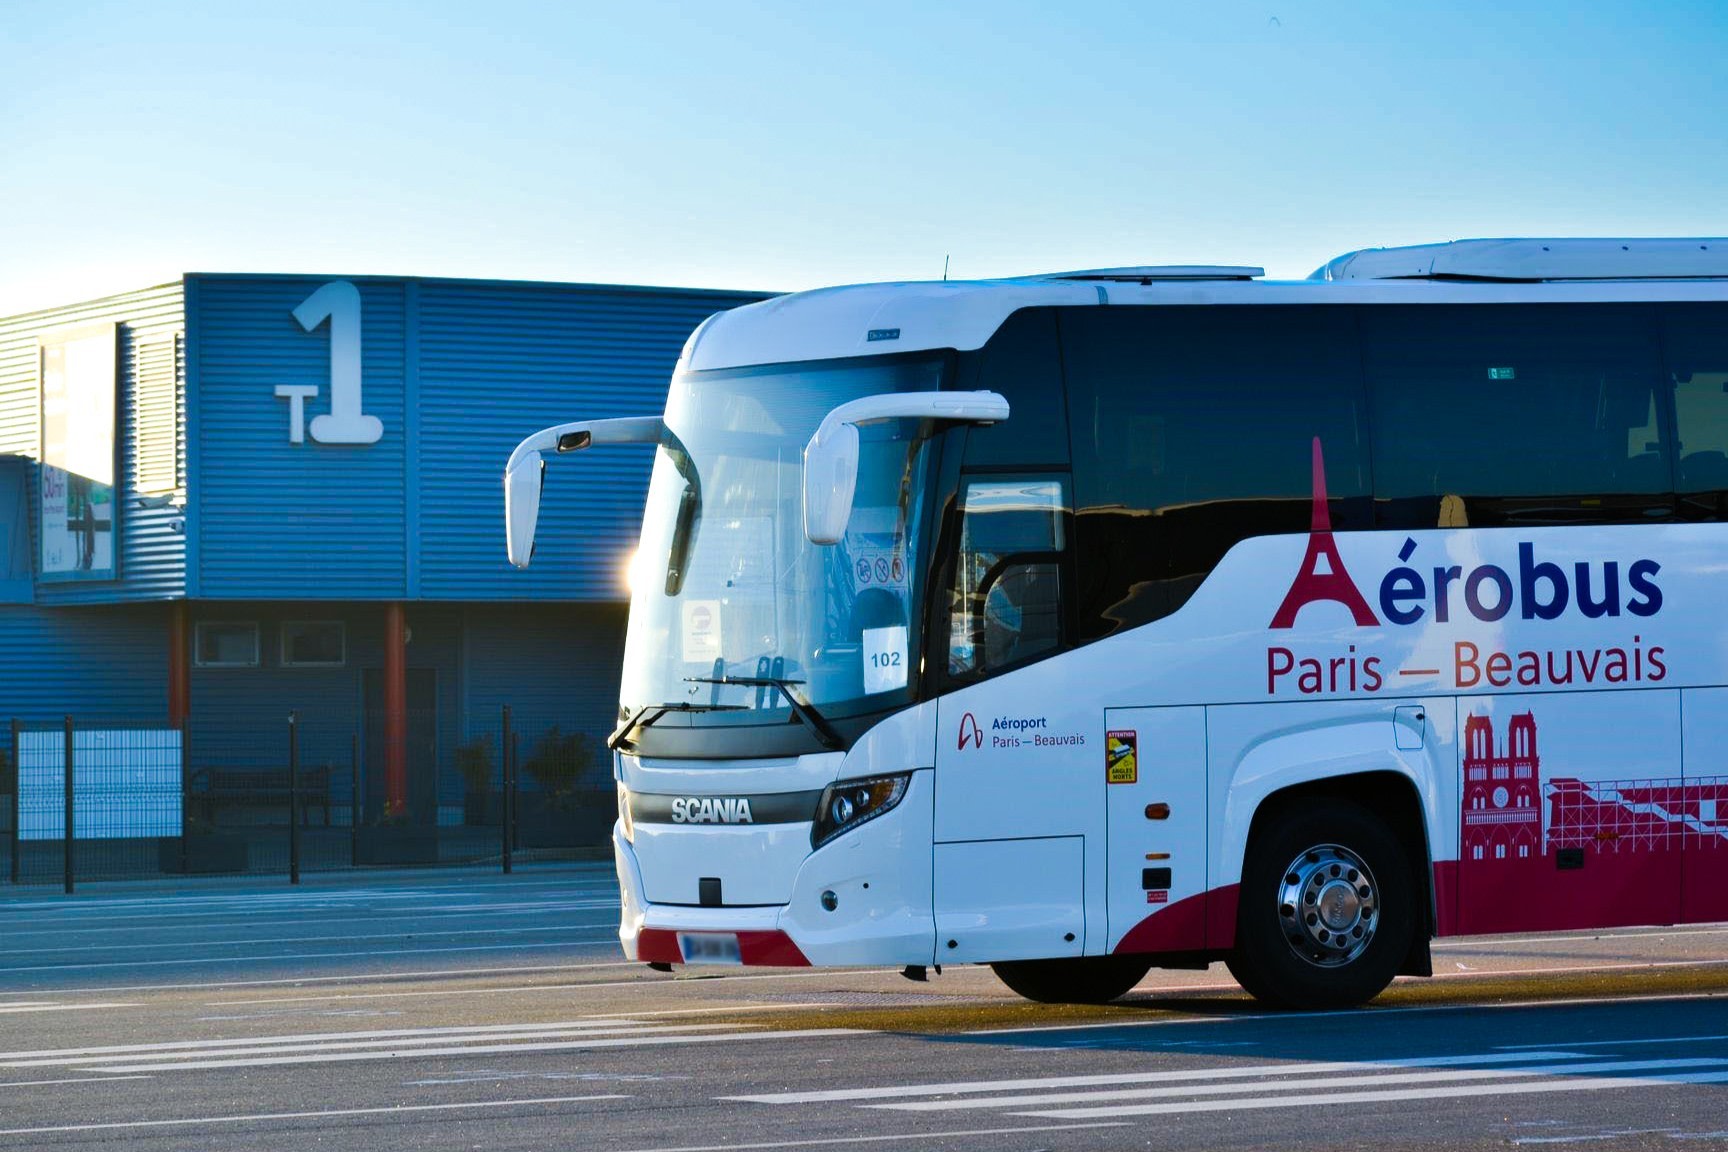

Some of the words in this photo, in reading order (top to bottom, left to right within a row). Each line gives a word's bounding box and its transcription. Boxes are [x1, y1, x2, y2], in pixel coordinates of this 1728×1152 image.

[871, 651, 901, 668] 102
[1267, 644, 1383, 694] Paris
[1454, 634, 1667, 688] Beauvais
[992, 715, 1047, 732] Aéroport
[992, 735, 1020, 748] Paris
[1034, 732, 1085, 747] Beauvais
[671, 797, 753, 823] SCANIA
